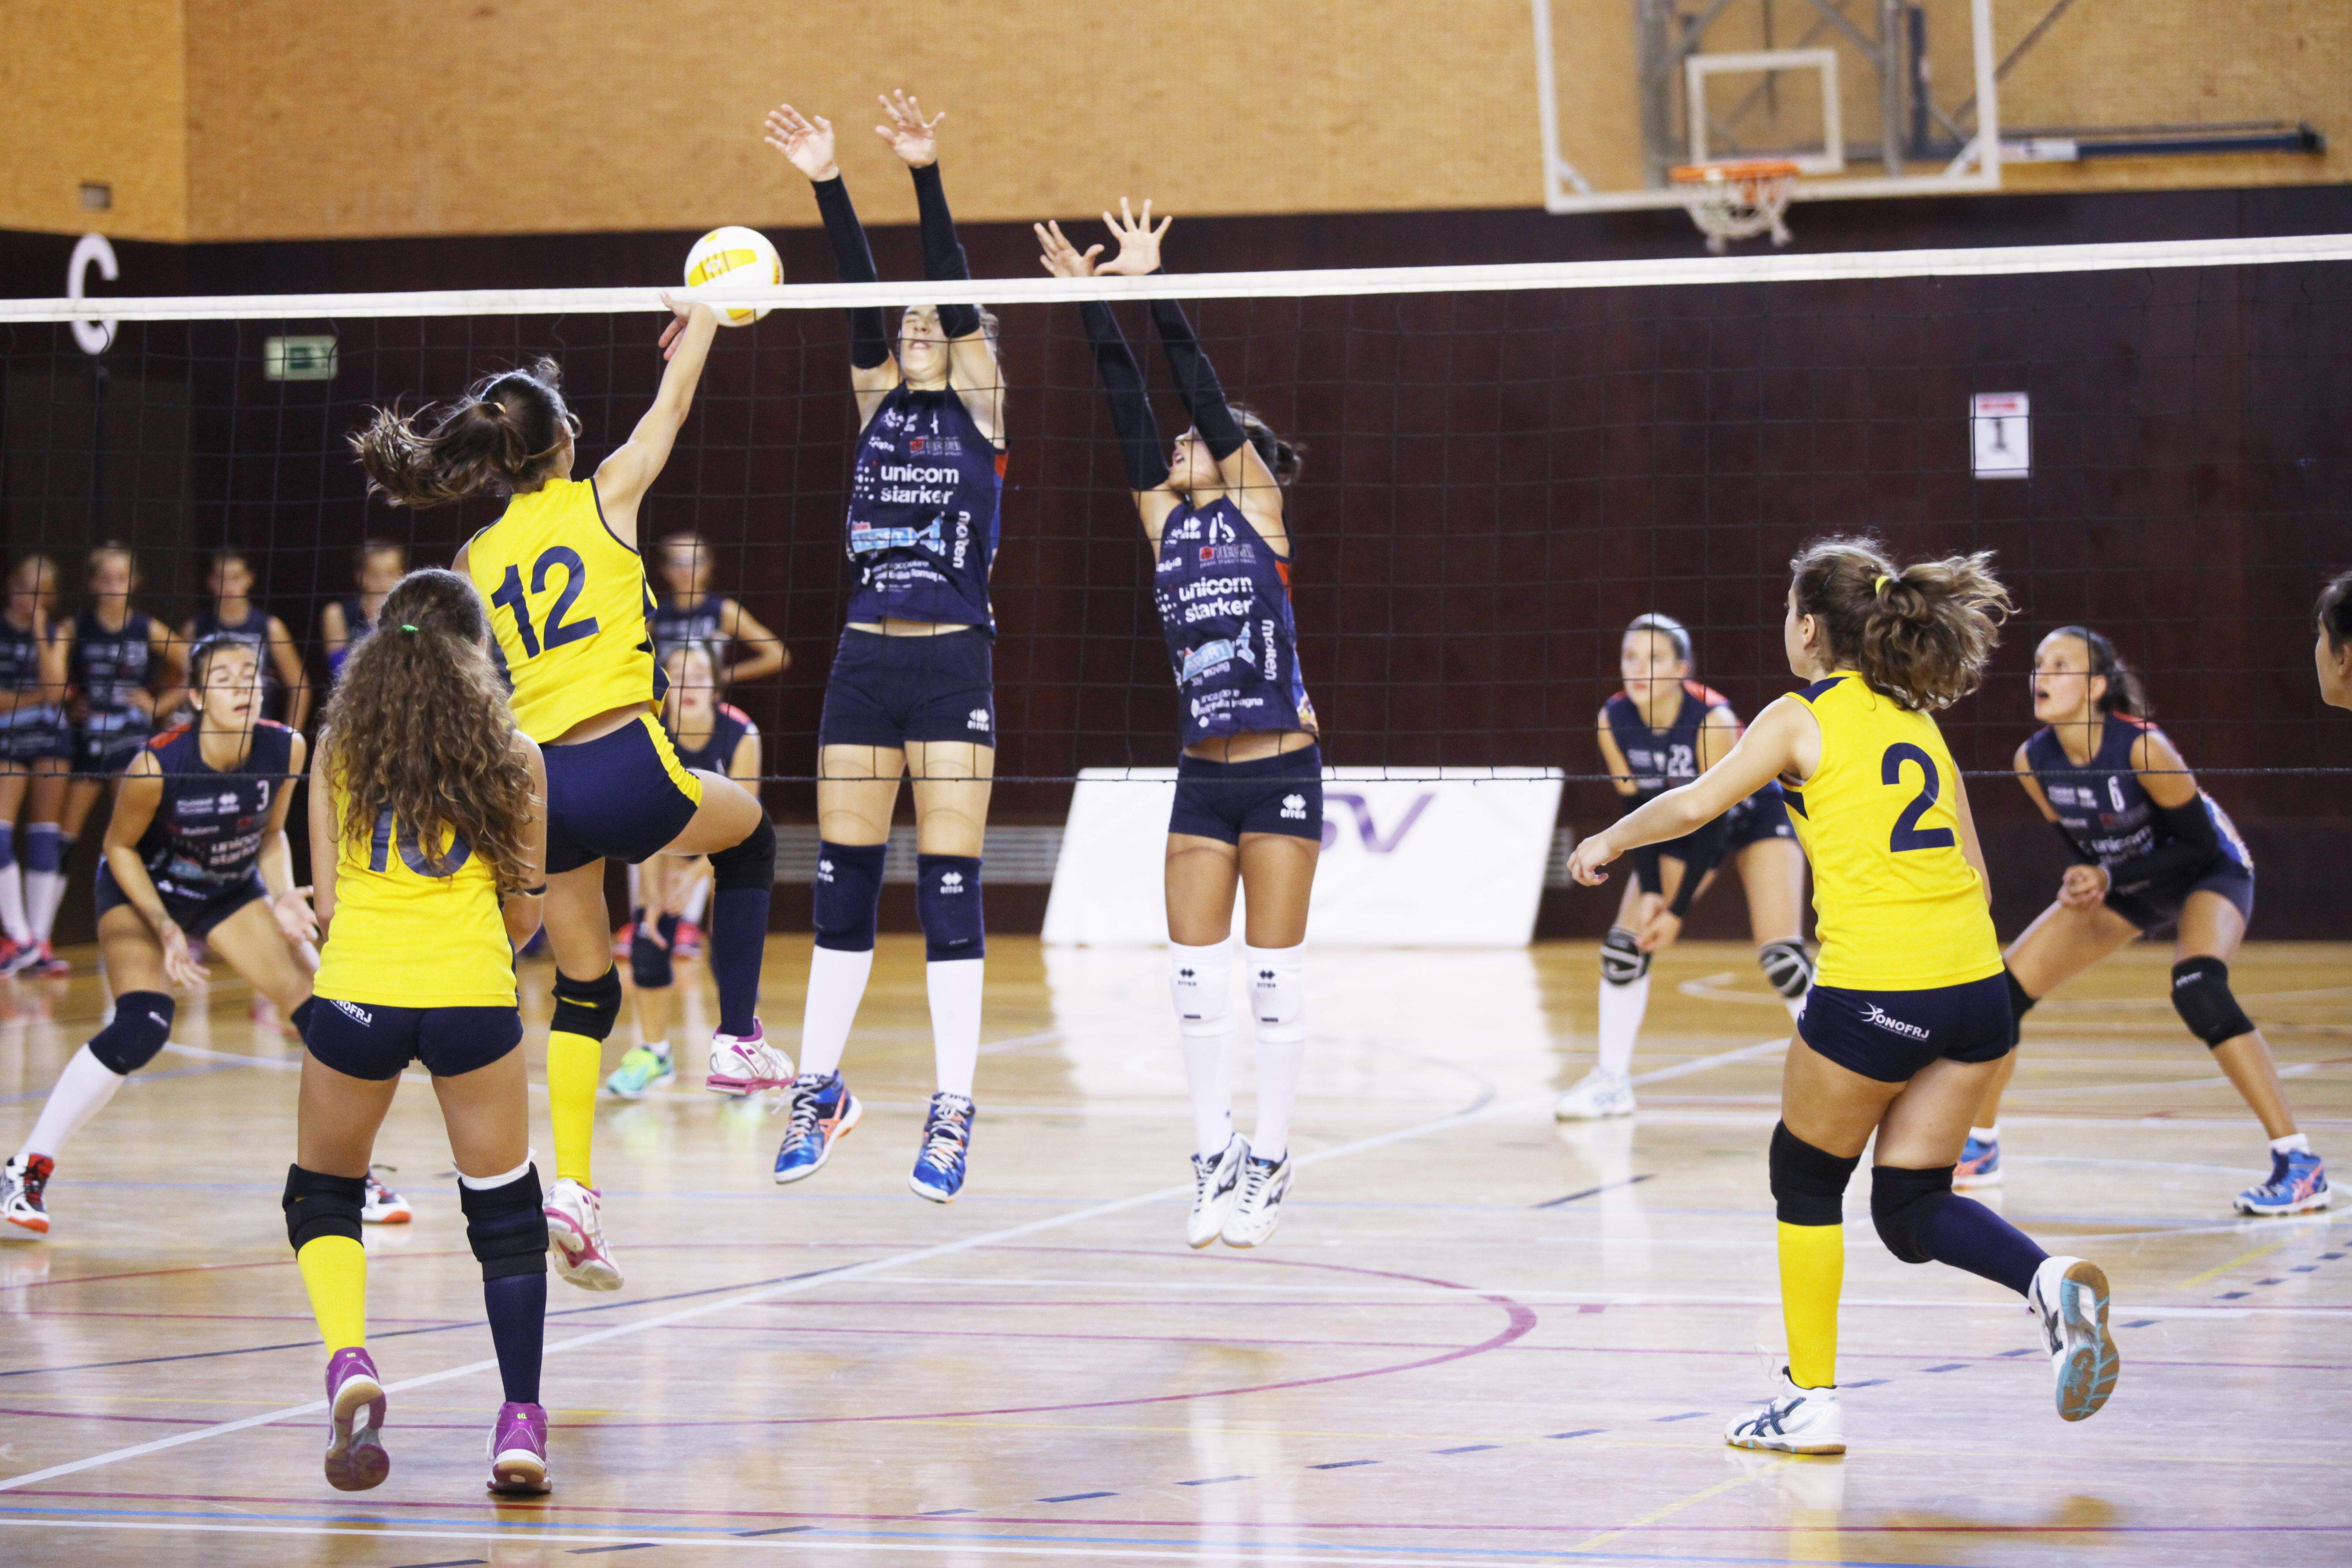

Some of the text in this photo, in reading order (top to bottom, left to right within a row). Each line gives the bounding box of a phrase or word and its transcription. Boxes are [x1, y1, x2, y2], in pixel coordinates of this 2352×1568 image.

[491, 545, 600, 659] 12
[1185, 597, 1253, 623] starker
[256, 780, 270, 812] 3
[1881, 742, 1955, 853] 2
[2108, 775, 2125, 812] 6
